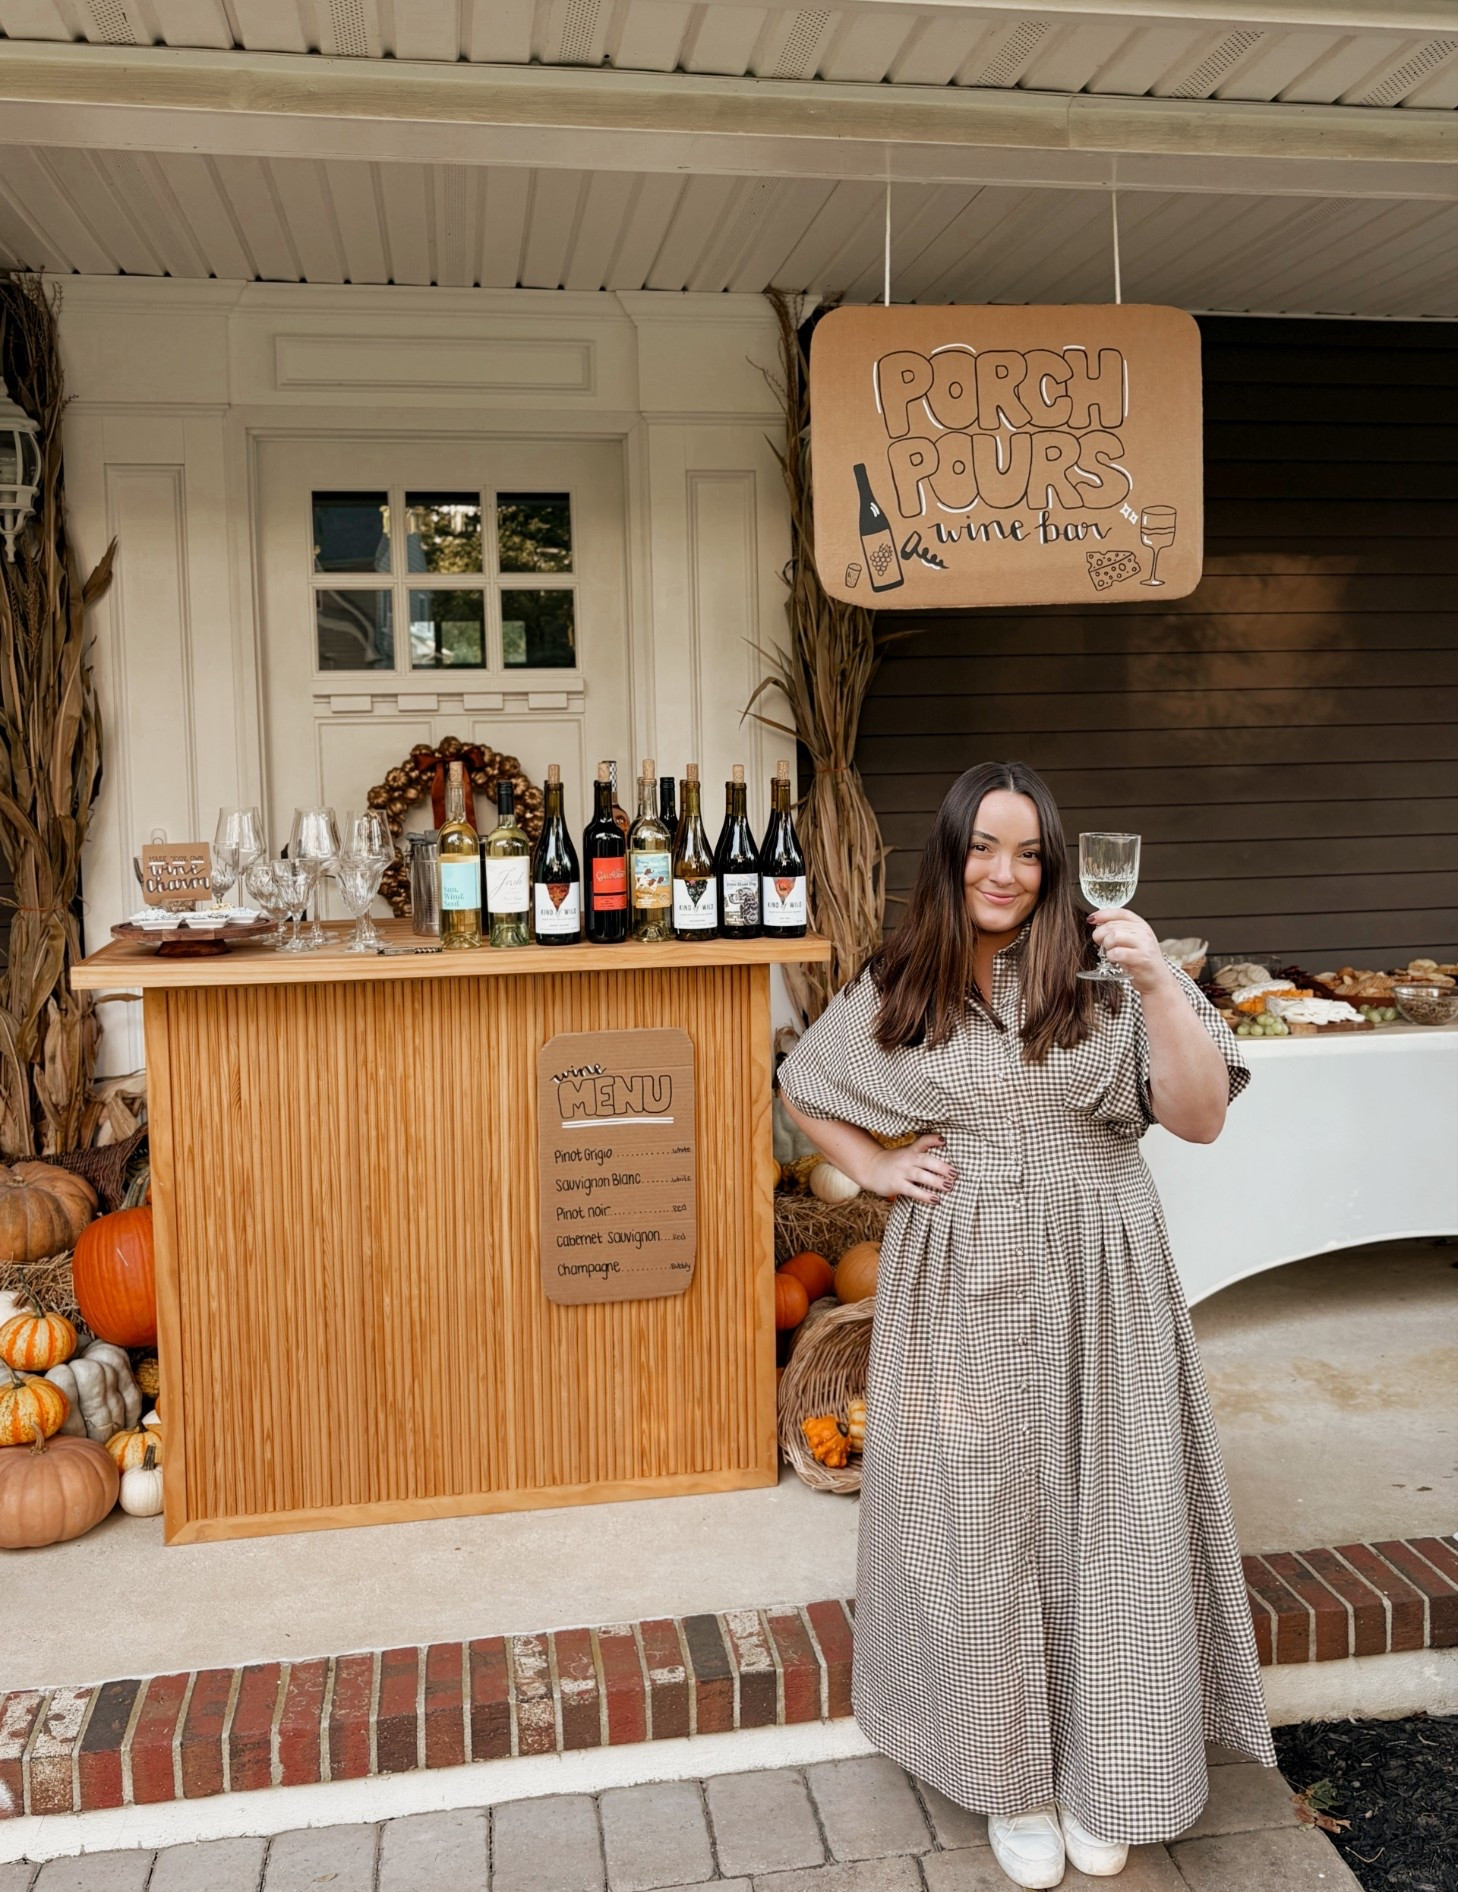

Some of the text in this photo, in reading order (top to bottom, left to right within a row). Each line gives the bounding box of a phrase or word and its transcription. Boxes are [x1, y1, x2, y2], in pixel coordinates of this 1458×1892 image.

[877, 348, 1124, 438] PORCH
[887, 430, 1131, 518] POURS
[926, 510, 1112, 545] wine bar
[147, 862, 206, 877] wine
[550, 1063, 607, 1084] wine
[557, 1075, 673, 1119] MENU
[554, 1148, 583, 1164] Pinot
[584, 1148, 613, 1166] Grigio
[611, 1173, 641, 1186] Blanc
[556, 1206, 585, 1221] Pinot
[557, 1261, 621, 1280] Champagne
